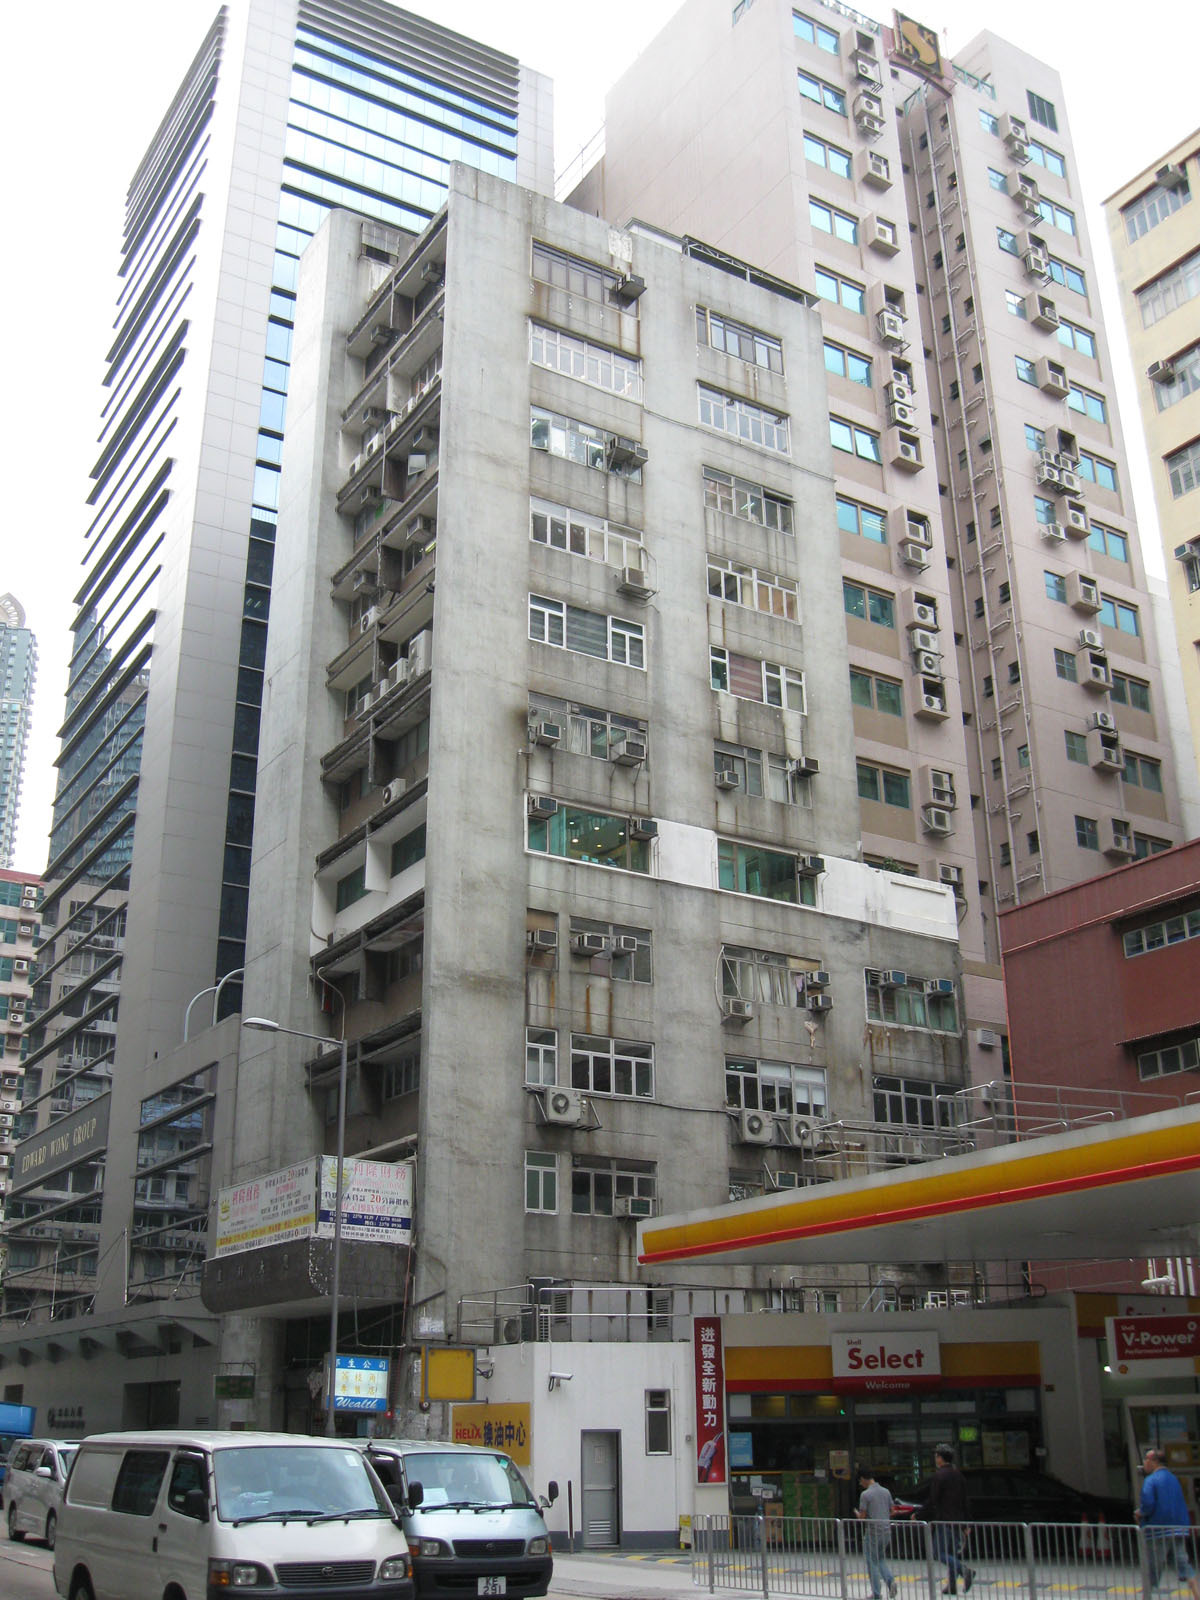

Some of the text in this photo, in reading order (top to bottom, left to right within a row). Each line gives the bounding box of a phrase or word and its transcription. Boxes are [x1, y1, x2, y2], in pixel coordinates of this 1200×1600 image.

[22, 1117, 97, 1174] EDWARD WONG GROUP
[1122, 1332, 1194, 1346] V-Power
[848, 1346, 924, 1369] Select
[865, 1380, 911, 1390] Welcome
[336, 1396, 378, 1408] Wealth
[455, 1421, 526, 1447] HELIX 換油中心
[483, 1585, 501, 1595] 291
